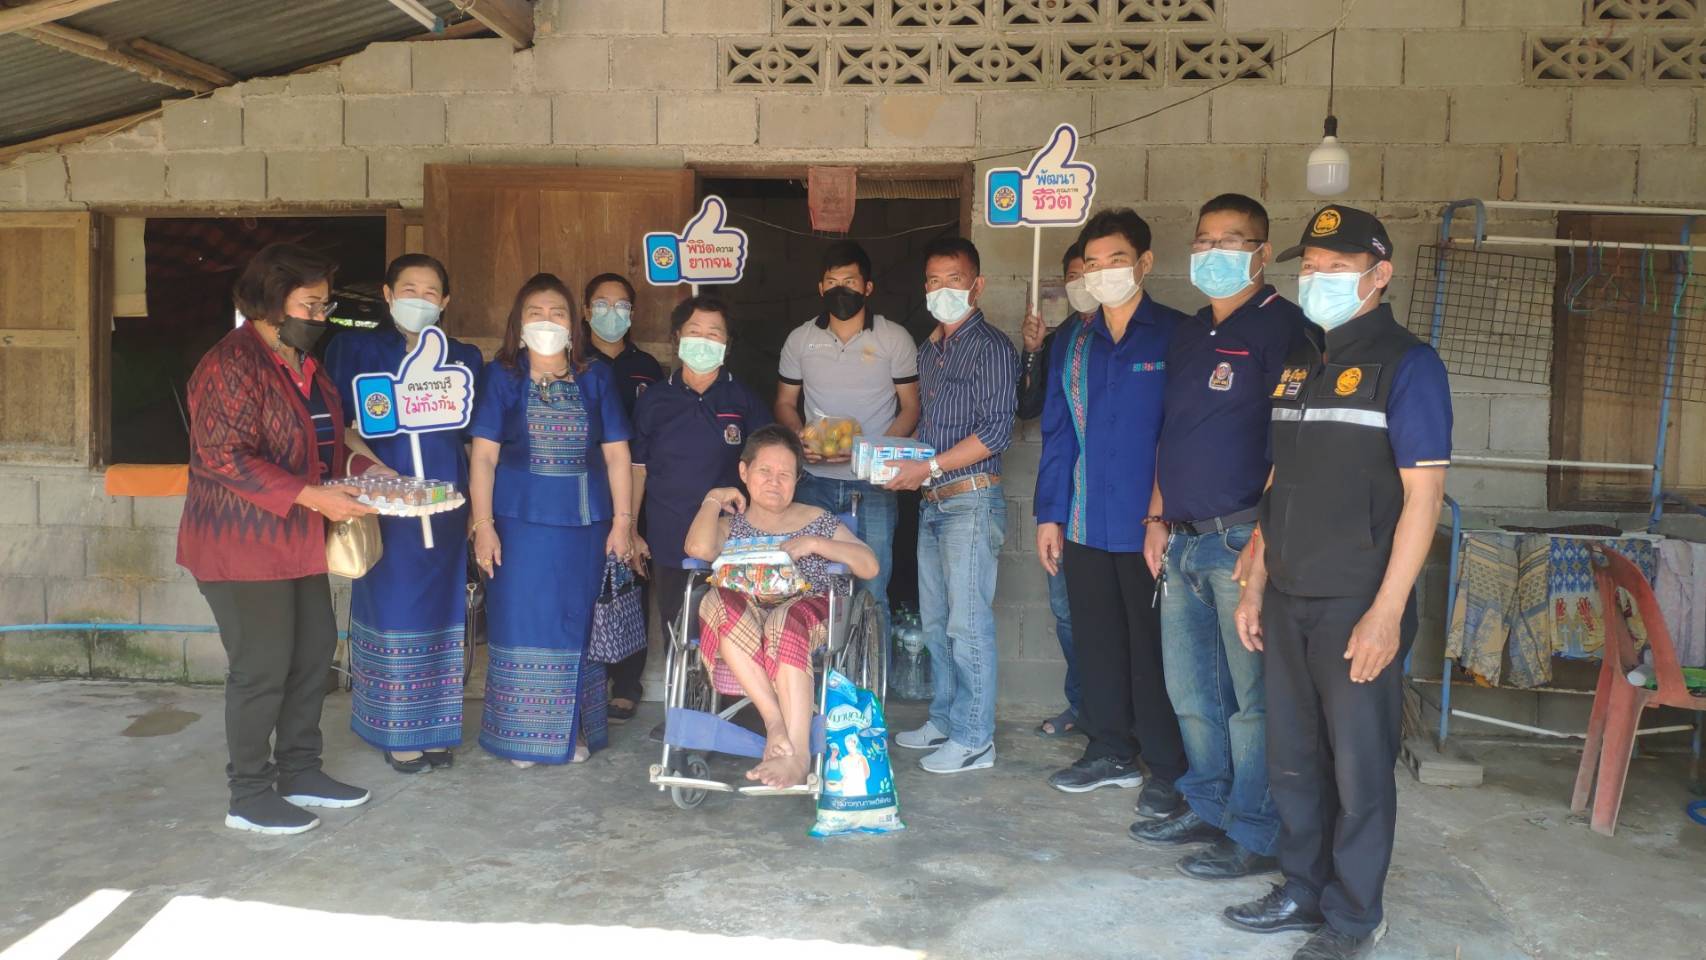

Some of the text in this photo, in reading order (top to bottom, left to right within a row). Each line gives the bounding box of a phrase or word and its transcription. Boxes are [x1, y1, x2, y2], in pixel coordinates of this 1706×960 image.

[1036, 169, 1076, 186] พัฒนา
[1032, 187, 1073, 210] ชีวิต
[686, 240, 716, 254] พิชิต
[688, 256, 733, 269] ยากจน
[407, 376, 453, 393] คนราชบุรี
[402, 393, 457, 415] ไม่ทิ้งกัน
